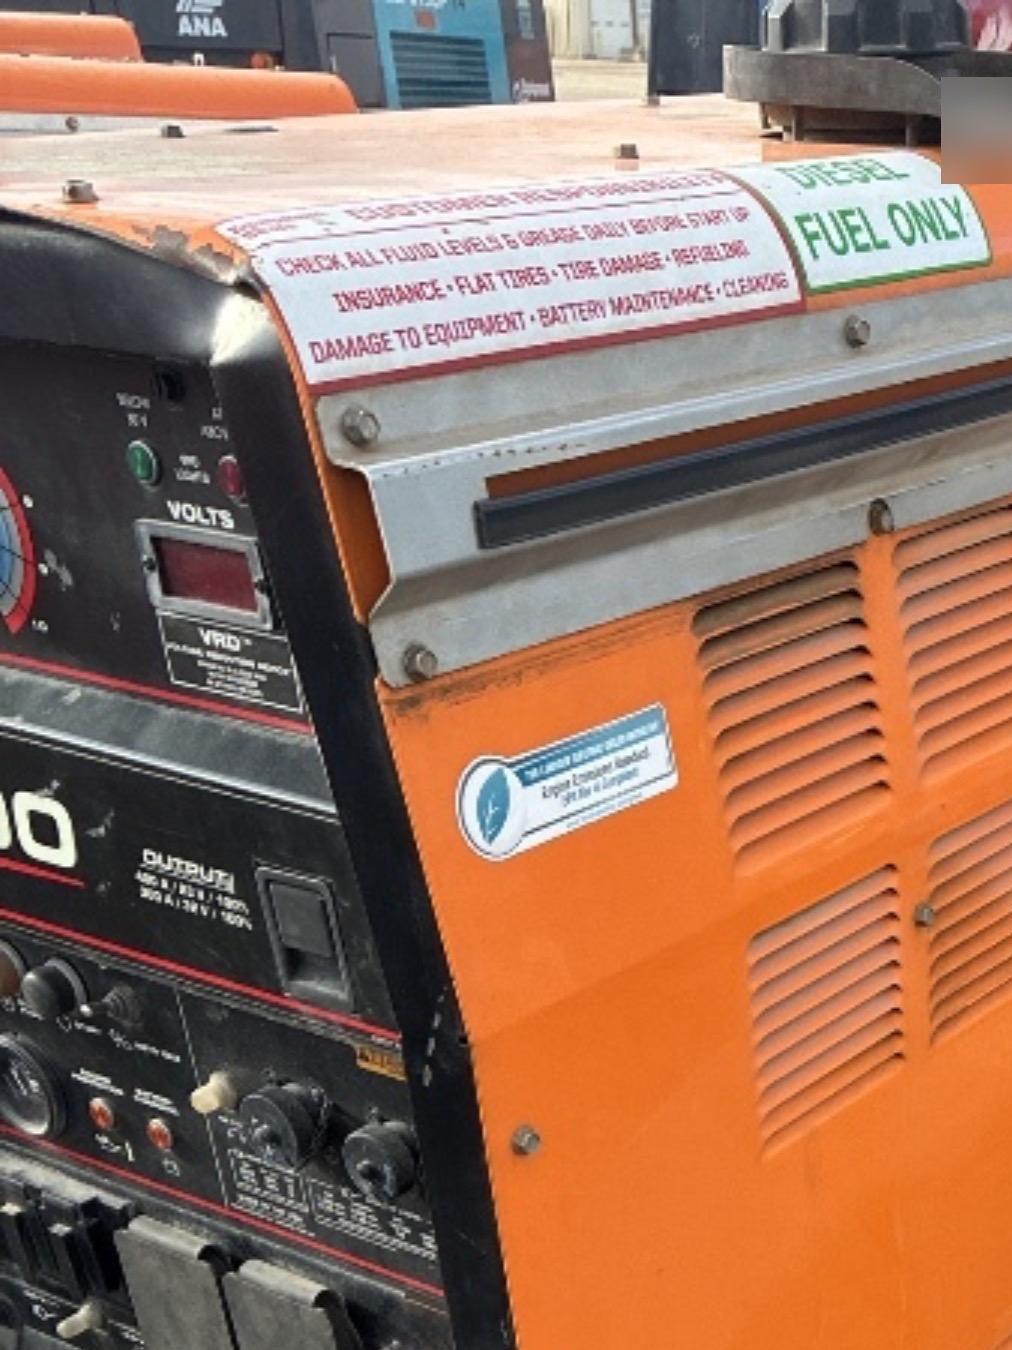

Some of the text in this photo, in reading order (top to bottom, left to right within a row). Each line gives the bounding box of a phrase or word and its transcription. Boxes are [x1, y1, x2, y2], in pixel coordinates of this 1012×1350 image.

[178, 14, 228, 37] ANA
[776, 156, 910, 190] DIESEL
[274, 254, 349, 277] CHECK
[343, 248, 384, 269] ALL
[380, 241, 440, 265] FLUID
[439, 234, 503, 256] LEVELS
[518, 226, 585, 246] GREASE
[582, 221, 630, 240] DAILY
[629, 214, 687, 234] BEFORE
[686, 208, 729, 228] START
[728, 206, 749, 222] UP
[794, 194, 970, 261] FUEL ONLY
[331, 239, 751, 313] INSURANCE FLAT TIRES TIRE DAMAGE REFUELING
[308, 270, 790, 364] DAMAGE TO EQUIPMENT BATTERY MAINTENANCE CLEANING
[166, 500, 235, 529] VOLTS
